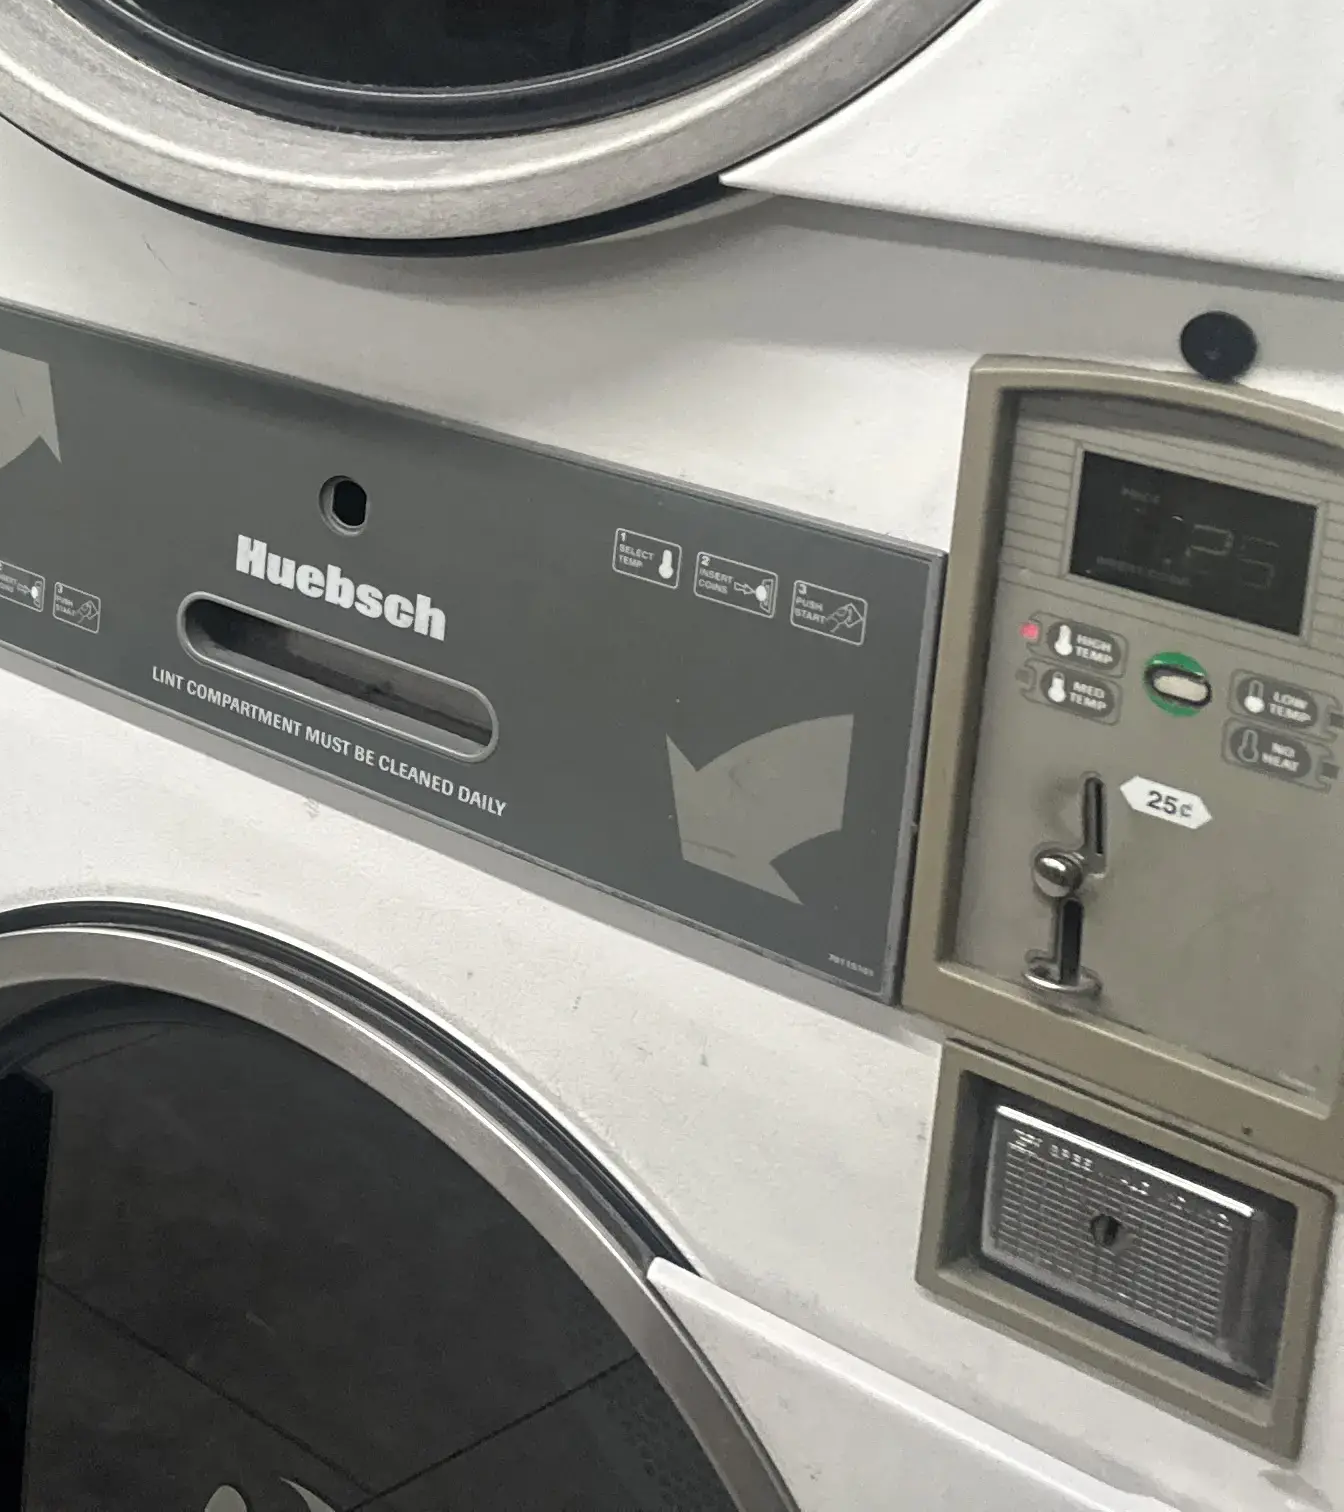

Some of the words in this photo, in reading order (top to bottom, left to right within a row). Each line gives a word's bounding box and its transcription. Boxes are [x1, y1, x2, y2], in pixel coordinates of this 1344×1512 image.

[619, 544, 655, 561] SELECT
[701, 555, 710, 567] 2
[236, 534, 446, 641] Huebsch
[798, 583, 807, 595] 3
[1075, 645, 1113, 664] TEMP
[1072, 681, 1105, 699] MED
[1069, 691, 1107, 711] TEMP
[1273, 691, 1309, 710] LOW
[152, 666, 183, 695] LINT
[186, 680, 302, 736] COMPARTMENT
[305, 725, 351, 756] MUST
[354, 745, 375, 766] BE
[378, 754, 454, 796] CLEANED
[457, 785, 507, 817] DAILY
[1271, 742, 1296, 758] NO
[1146, 789, 1194, 819] 25¢
